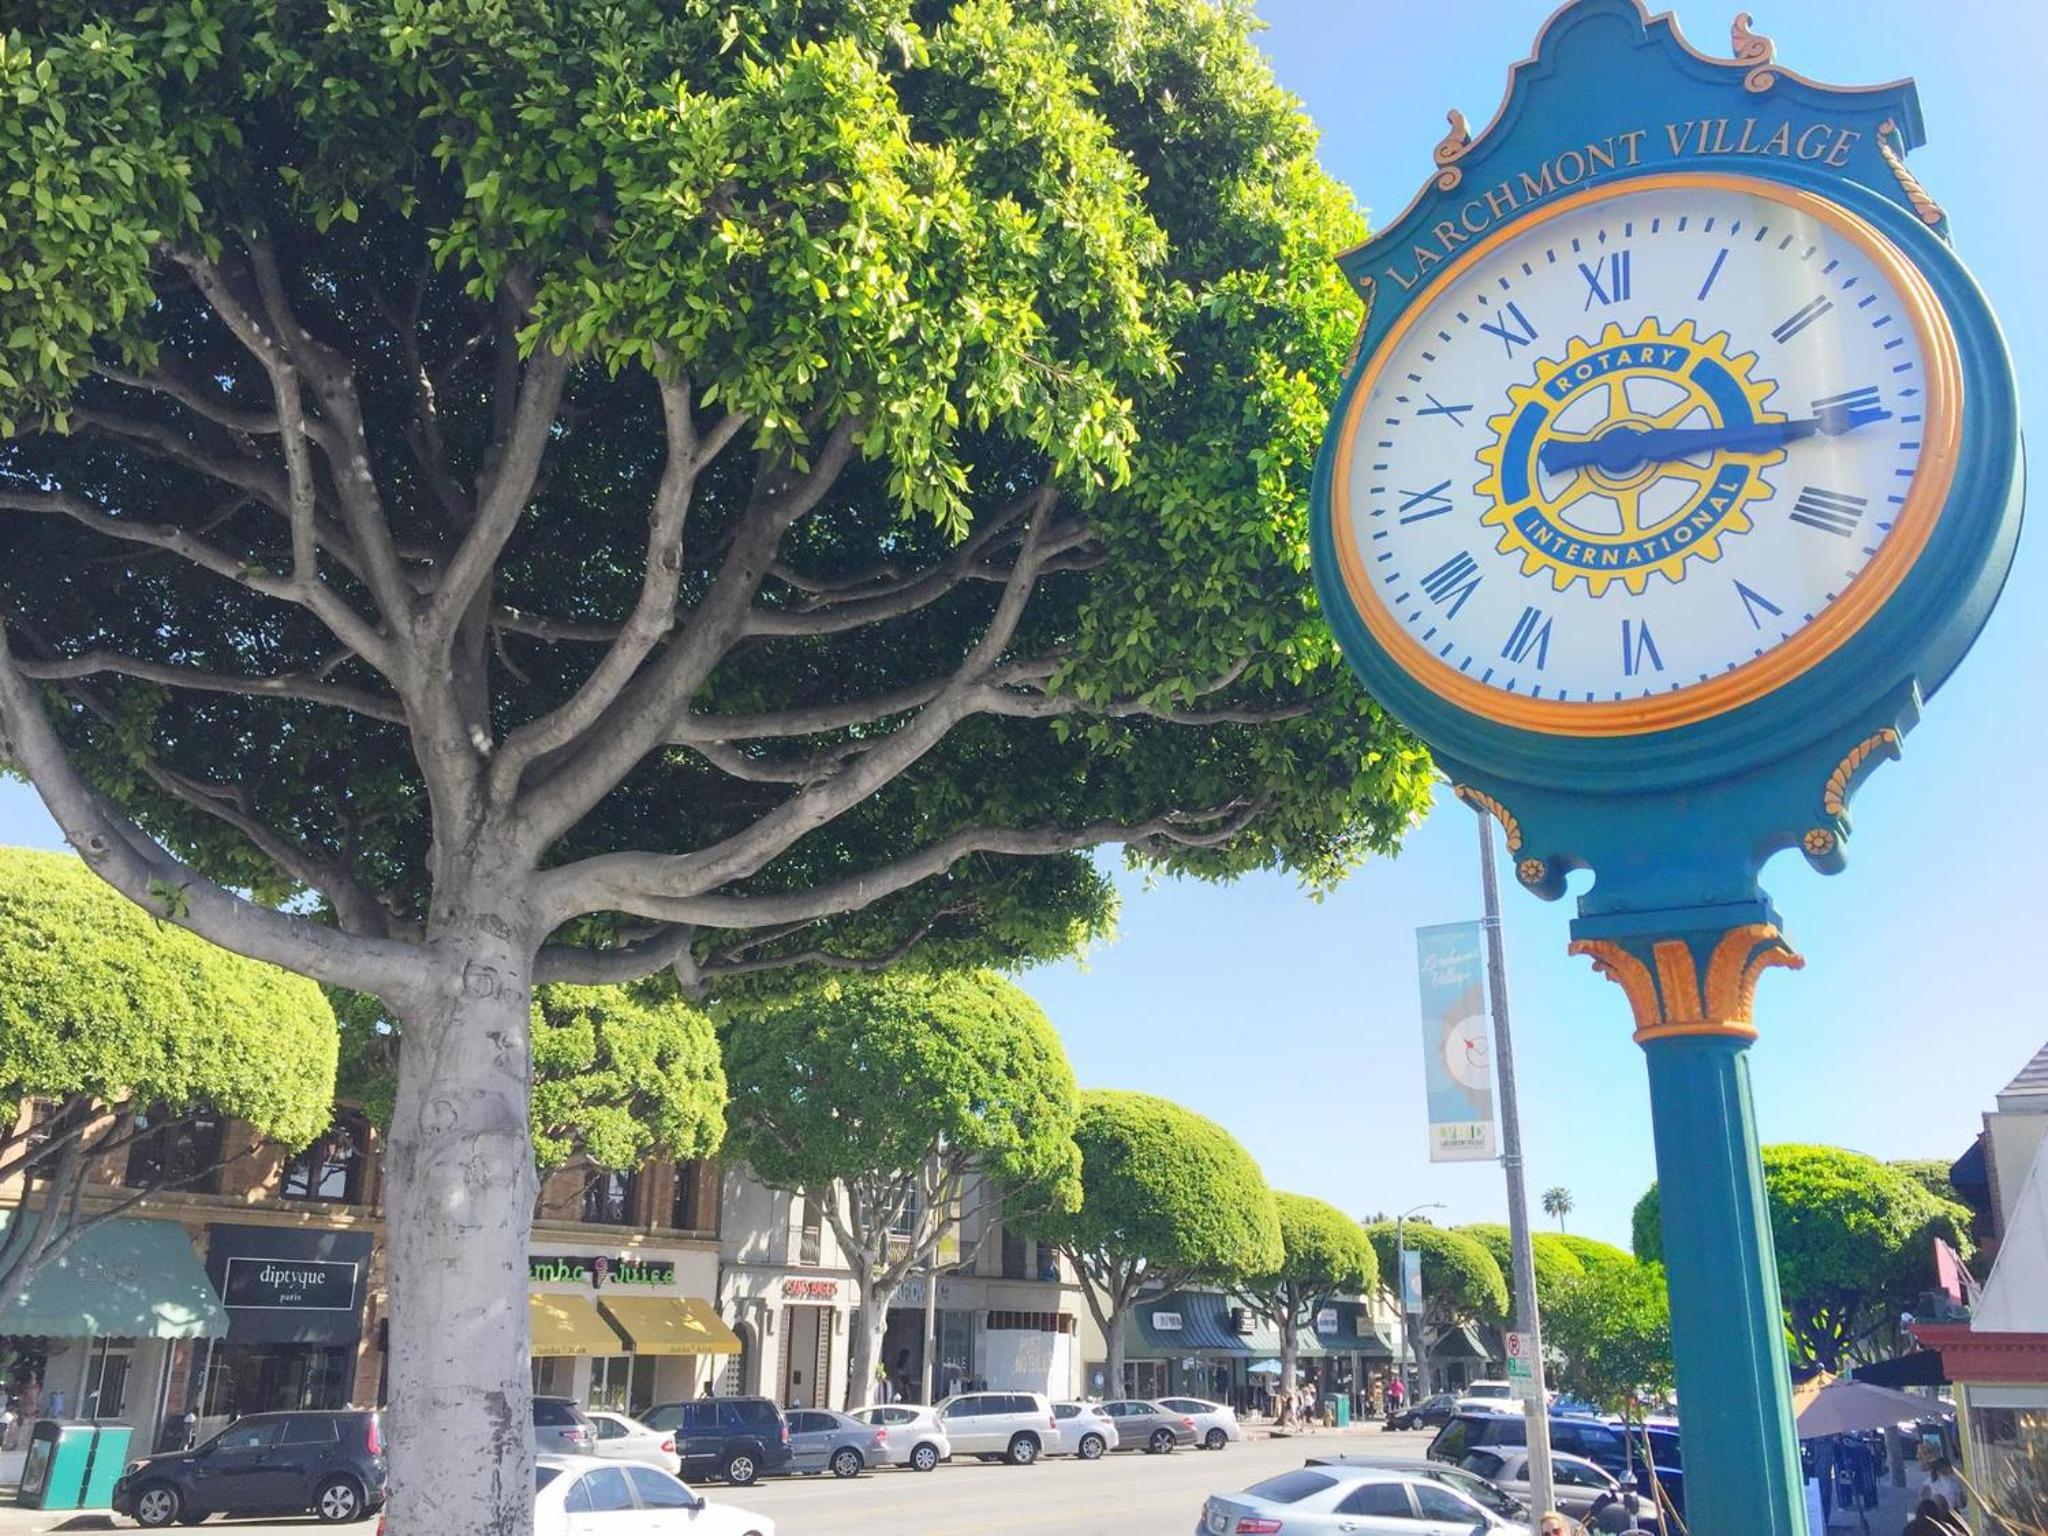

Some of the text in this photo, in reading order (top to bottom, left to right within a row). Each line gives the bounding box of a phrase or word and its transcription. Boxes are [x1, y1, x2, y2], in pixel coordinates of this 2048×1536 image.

[1386, 117, 1862, 290] LARCHMONT VILLAGE
[1578, 250, 1631, 312] XII
[1480, 301, 1539, 359] XI
[1555, 348, 1677, 392] ROTARY
[1416, 393, 1474, 428] X
[1399, 479, 1453, 525] IX
[1525, 481, 1739, 566] INTERNATIONAL
[1420, 550, 1485, 621] VIII
[1501, 606, 1553, 670] VII
[1622, 618, 1664, 677] VI
[260, 1264, 326, 1289] diptyque
[279, 1292, 302, 1304] paris
[529, 1258, 585, 1282] mba
